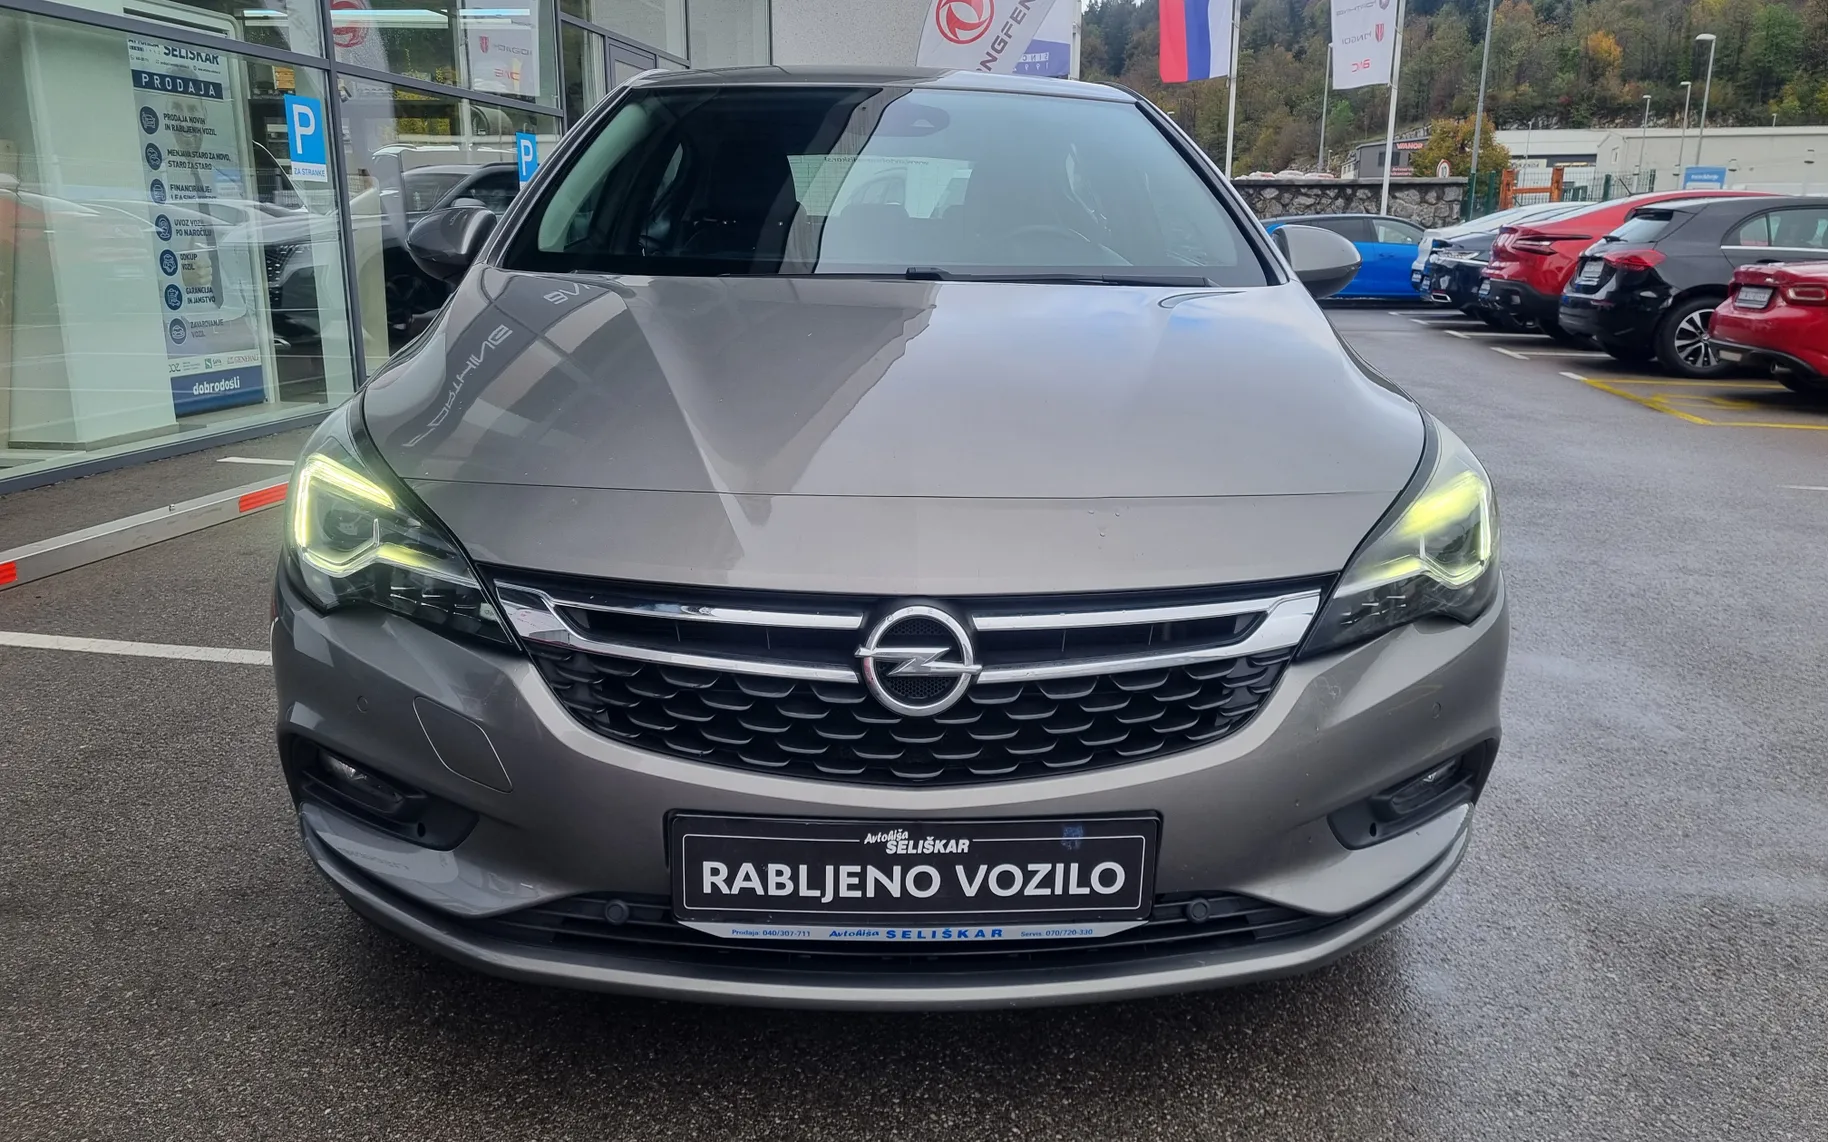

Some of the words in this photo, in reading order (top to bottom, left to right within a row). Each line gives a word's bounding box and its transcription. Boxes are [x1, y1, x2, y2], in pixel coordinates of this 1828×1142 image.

[141, 73, 216, 97] PRODAJA
[163, 113, 188, 122] PRODAJA
[292, 104, 316, 154] P
[167, 149, 192, 158] MENJAVA
[192, 151, 208, 159] STARO
[208, 152, 216, 160] ZA
[520, 139, 534, 176] P
[168, 160, 187, 169] STARO
[187, 162, 194, 170] ZA
[195, 162, 212, 170] STARO
[302, 168, 325, 177] STRANKE
[174, 219, 189, 227] UVOZ
[176, 229, 183, 237] PO
[184, 227, 212, 237] NAROČILU
[186, 286, 214, 295] GARANCIJA
[190, 319, 224, 329] ZAVAROVANJE
[886, 836, 970, 854] SELIŠKAR
[702, 861, 941, 904] RABLJENO
[955, 861, 1126, 898] VOZILO
[886, 928, 1003, 940] SELIŠKAR
